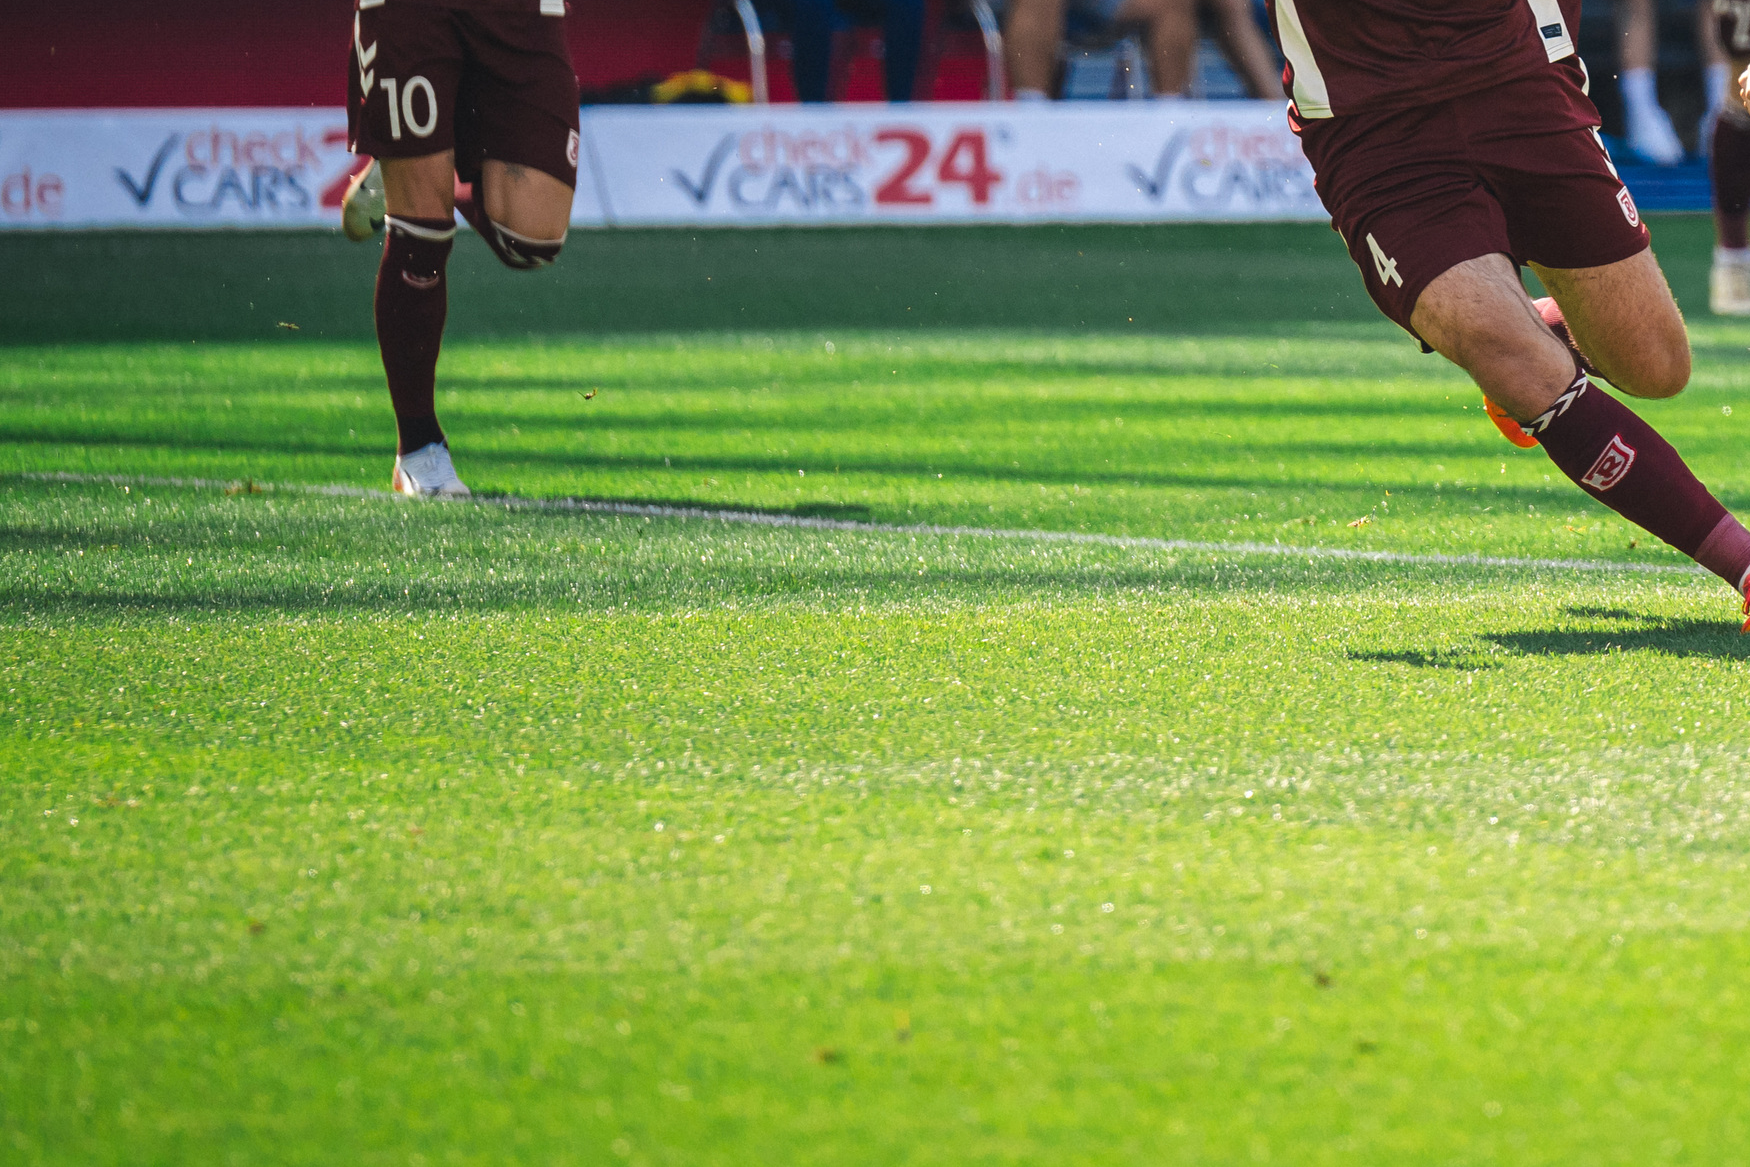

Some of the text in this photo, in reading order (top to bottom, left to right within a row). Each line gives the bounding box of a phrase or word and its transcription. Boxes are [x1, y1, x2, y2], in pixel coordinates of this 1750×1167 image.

[380, 75, 437, 140] 10
[185, 125, 323, 174] check
[873, 124, 1003, 206] 24
[172, 162, 313, 214] CARS
[1366, 233, 1404, 289] 4
